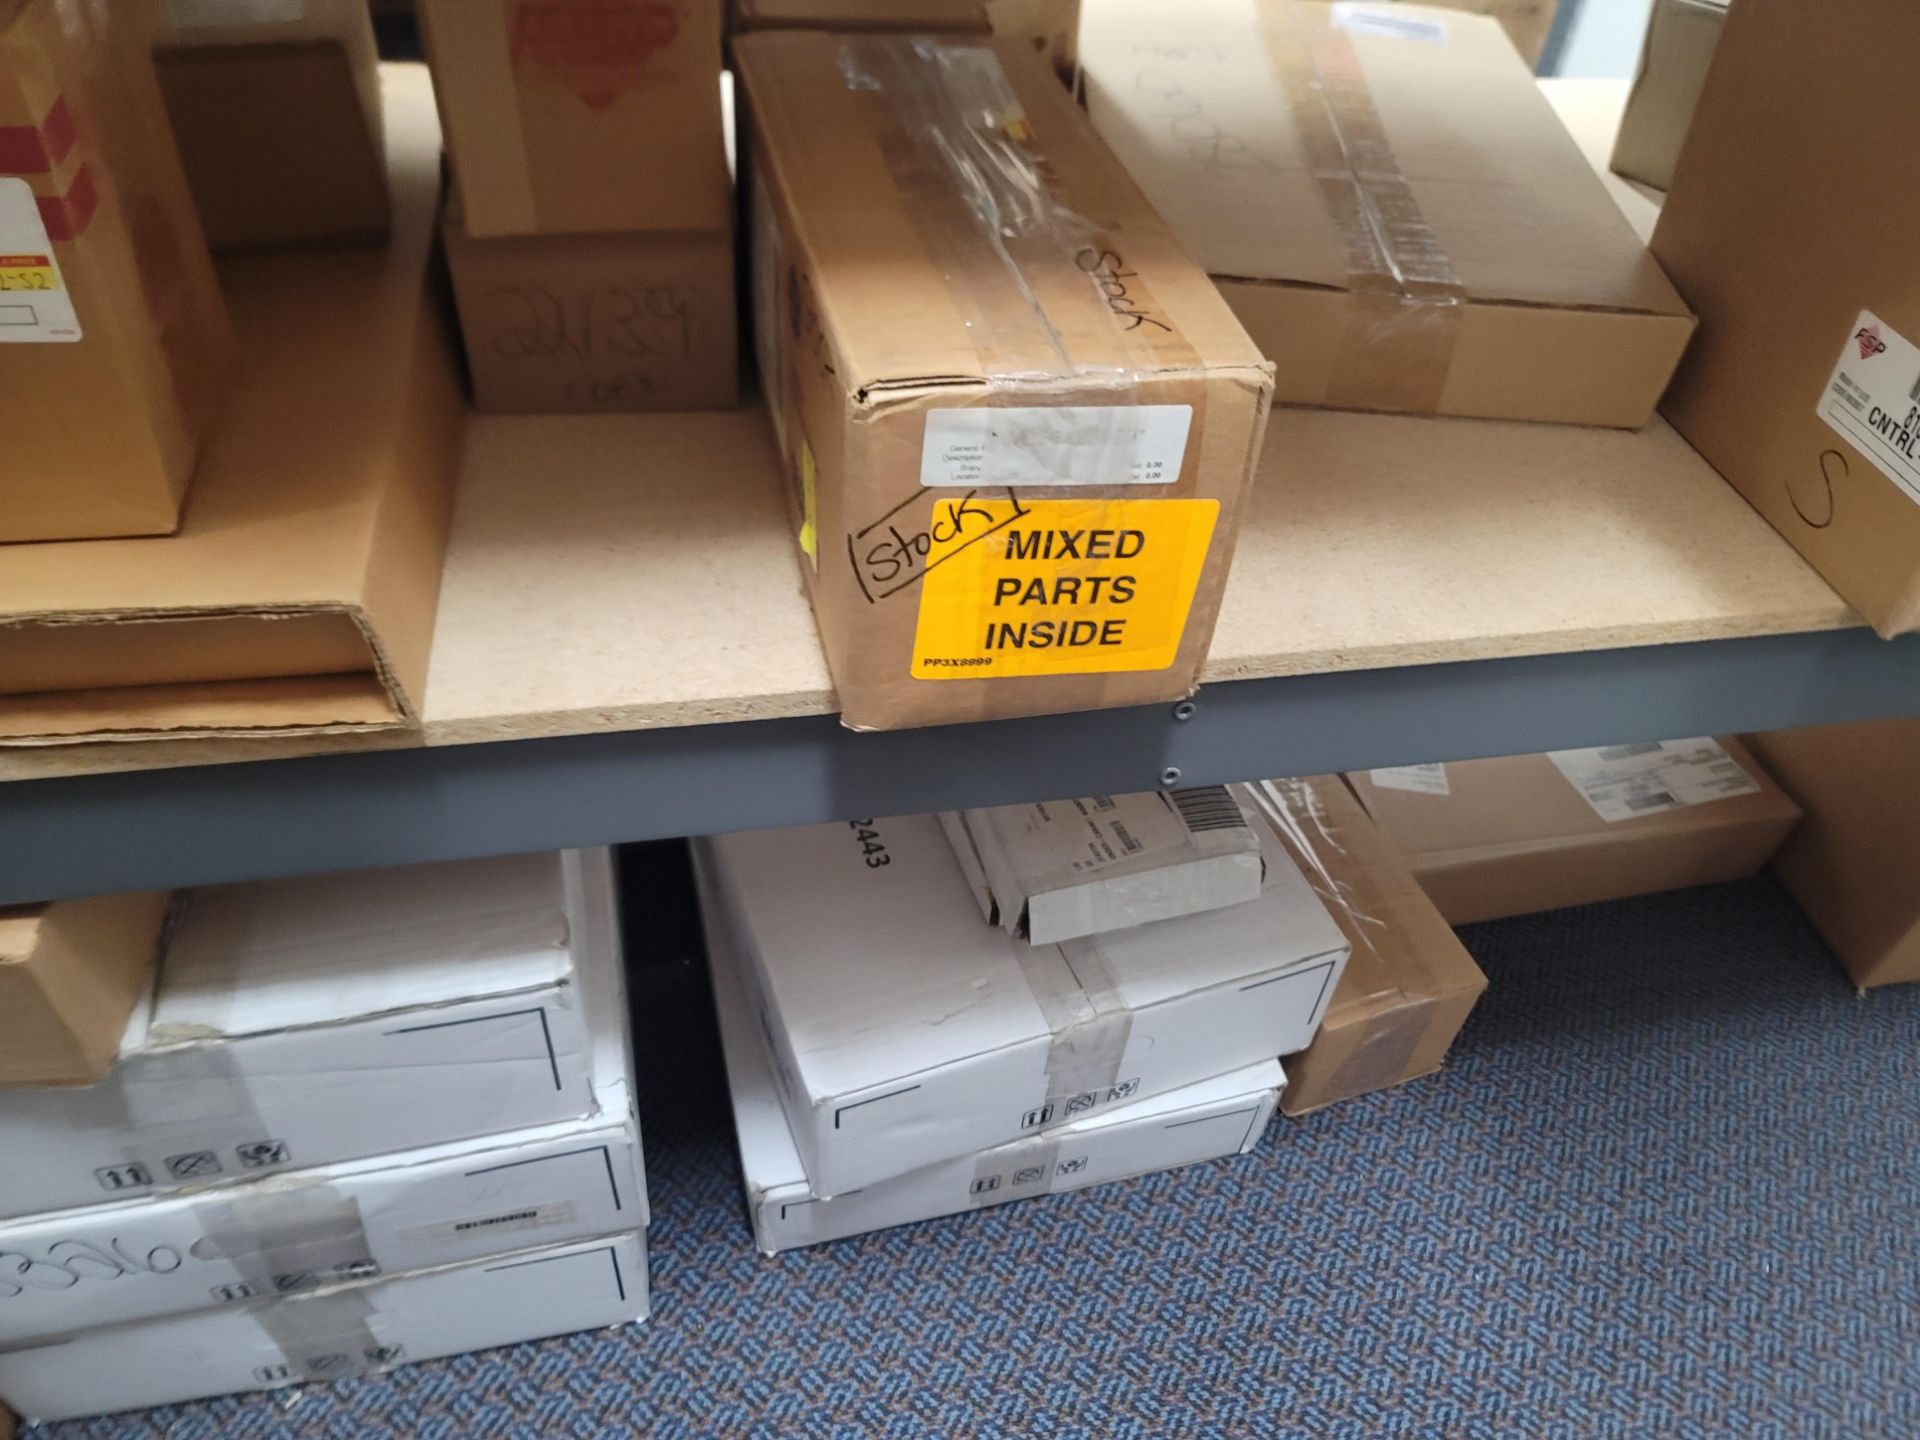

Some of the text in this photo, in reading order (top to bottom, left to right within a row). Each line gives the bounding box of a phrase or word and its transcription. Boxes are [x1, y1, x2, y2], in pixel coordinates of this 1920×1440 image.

[1075, 248, 1173, 332] Stock
[1855, 327, 1887, 355] FSP
[1868, 406, 1920, 460] CNTRL
[866, 489, 994, 582] Stock
[1005, 529, 1145, 560] MIXED
[994, 576, 1137, 606] PARTS
[985, 620, 1127, 649] INSIDE
